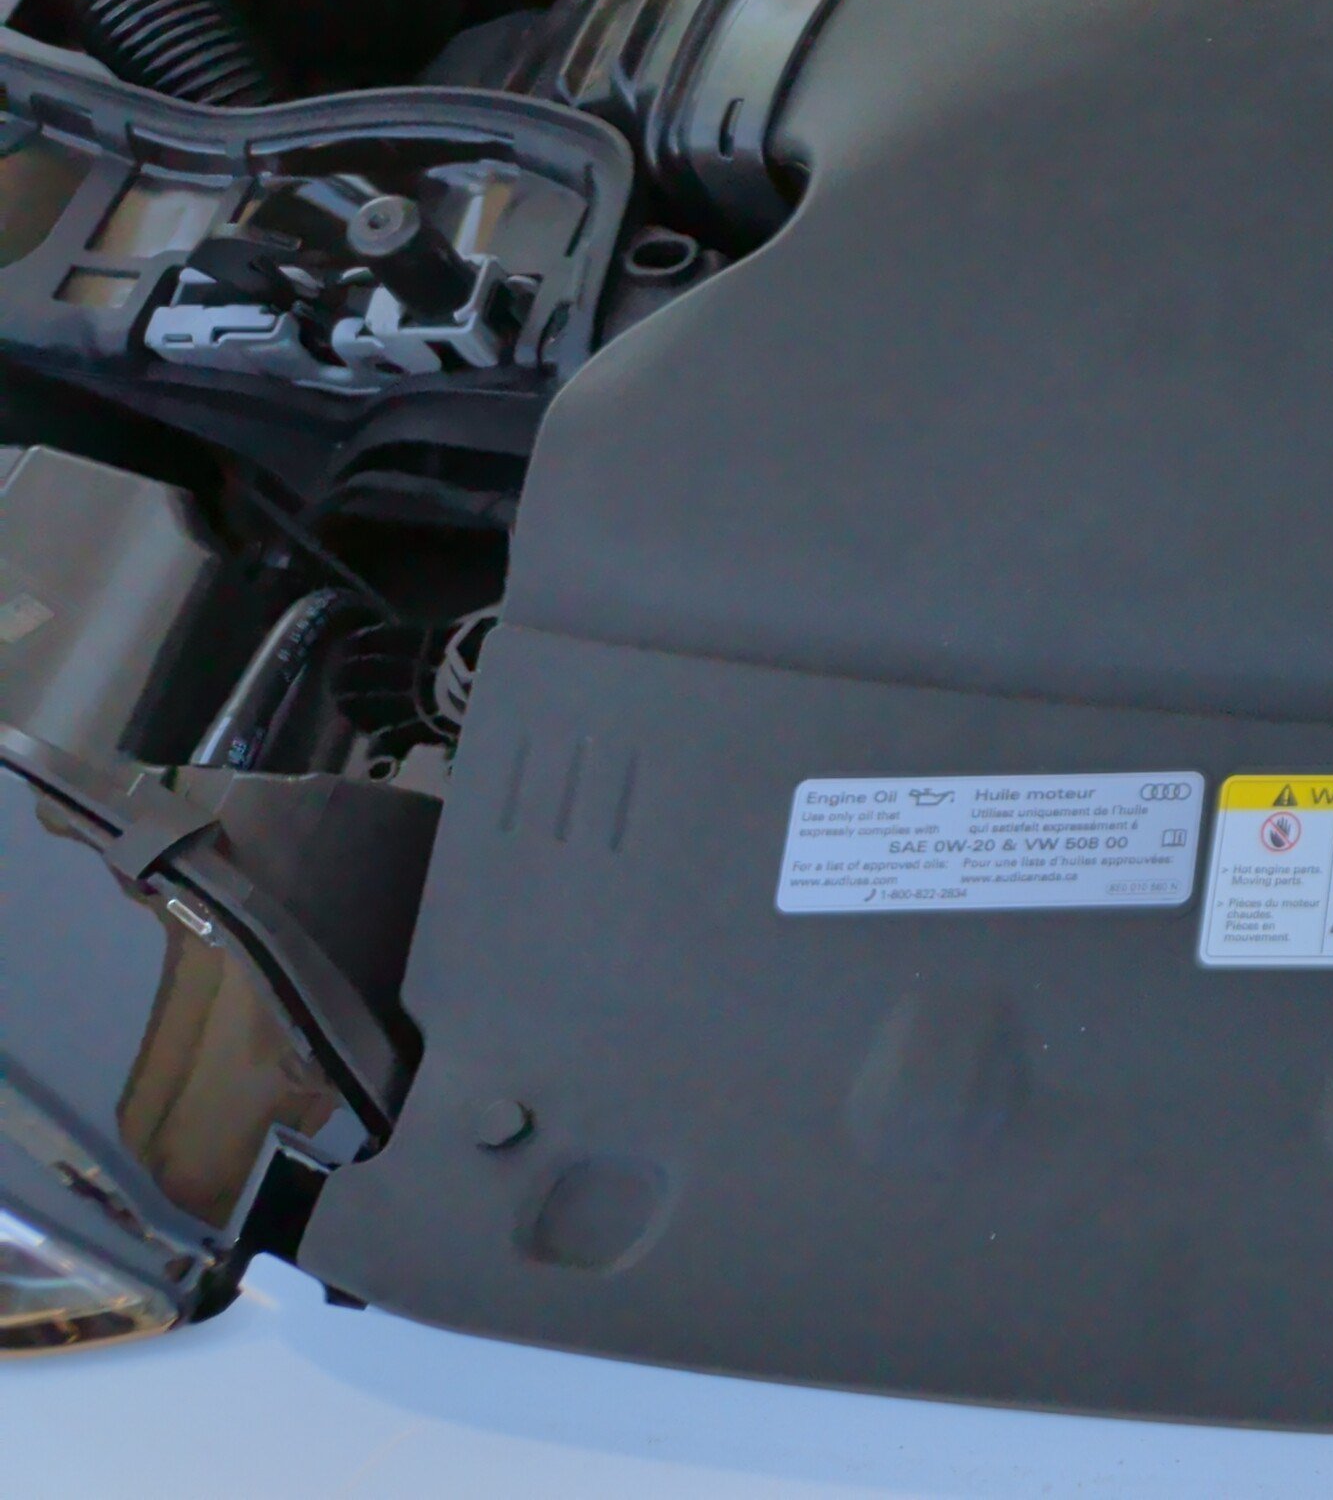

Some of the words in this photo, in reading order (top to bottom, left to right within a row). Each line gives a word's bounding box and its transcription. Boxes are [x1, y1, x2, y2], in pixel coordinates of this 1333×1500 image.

[806, 792, 867, 806] Engine
[874, 790, 897, 803] Oil
[975, 789, 1020, 801] Huile
[1027, 789, 1096, 800] moteur
[802, 812, 824, 821] Use
[828, 812, 854, 822] only
[858, 811, 873, 821] oil
[877, 811, 900, 820] that
[971, 808, 1014, 818] Utilisez
[1018, 808, 1090, 819] uniquement
[1093, 806, 1108, 816] de
[1112, 805, 1148, 815] l'huile
[799, 826, 855, 837] expressly
[858, 825, 910, 837] complies
[915, 825, 940, 835] with
[969, 824, 989, 834] qui
[992, 822, 1040, 833] satisfait
[1042, 821, 1128, 832] expressément
[889, 840, 927, 853] SAE
[934, 839, 996, 853] 0W-20
[1002, 839, 1016, 851] &
[1025, 838, 1059, 850] VW
[1066, 837, 1098, 850] 508
[1105, 837, 1128, 849] 00
[792, 861, 812, 872] For
[815, 863, 822, 871] a
[826, 861, 843, 871] list
[848, 860, 858, 870] of
[863, 859, 920, 871] approved
[923, 858, 949, 869] oils:
[963, 858, 991, 868] Pour
[994, 859, 1017, 867] une
[1021, 857, 1045, 867] liste
[1233, 865, 1252, 874] Hot
[1255, 865, 1290, 875] engine
[790, 876, 898, 886] www.audiusa.com
[961, 872, 1078, 883] www.audicanada.ca
[1232, 876, 1272, 886] Moving
[881, 889, 967, 899] 1-800-822-2834
[1265, 899, 1278, 907] du
[1282, 899, 1320, 907] moteur
[1262, 922, 1275, 930] en
